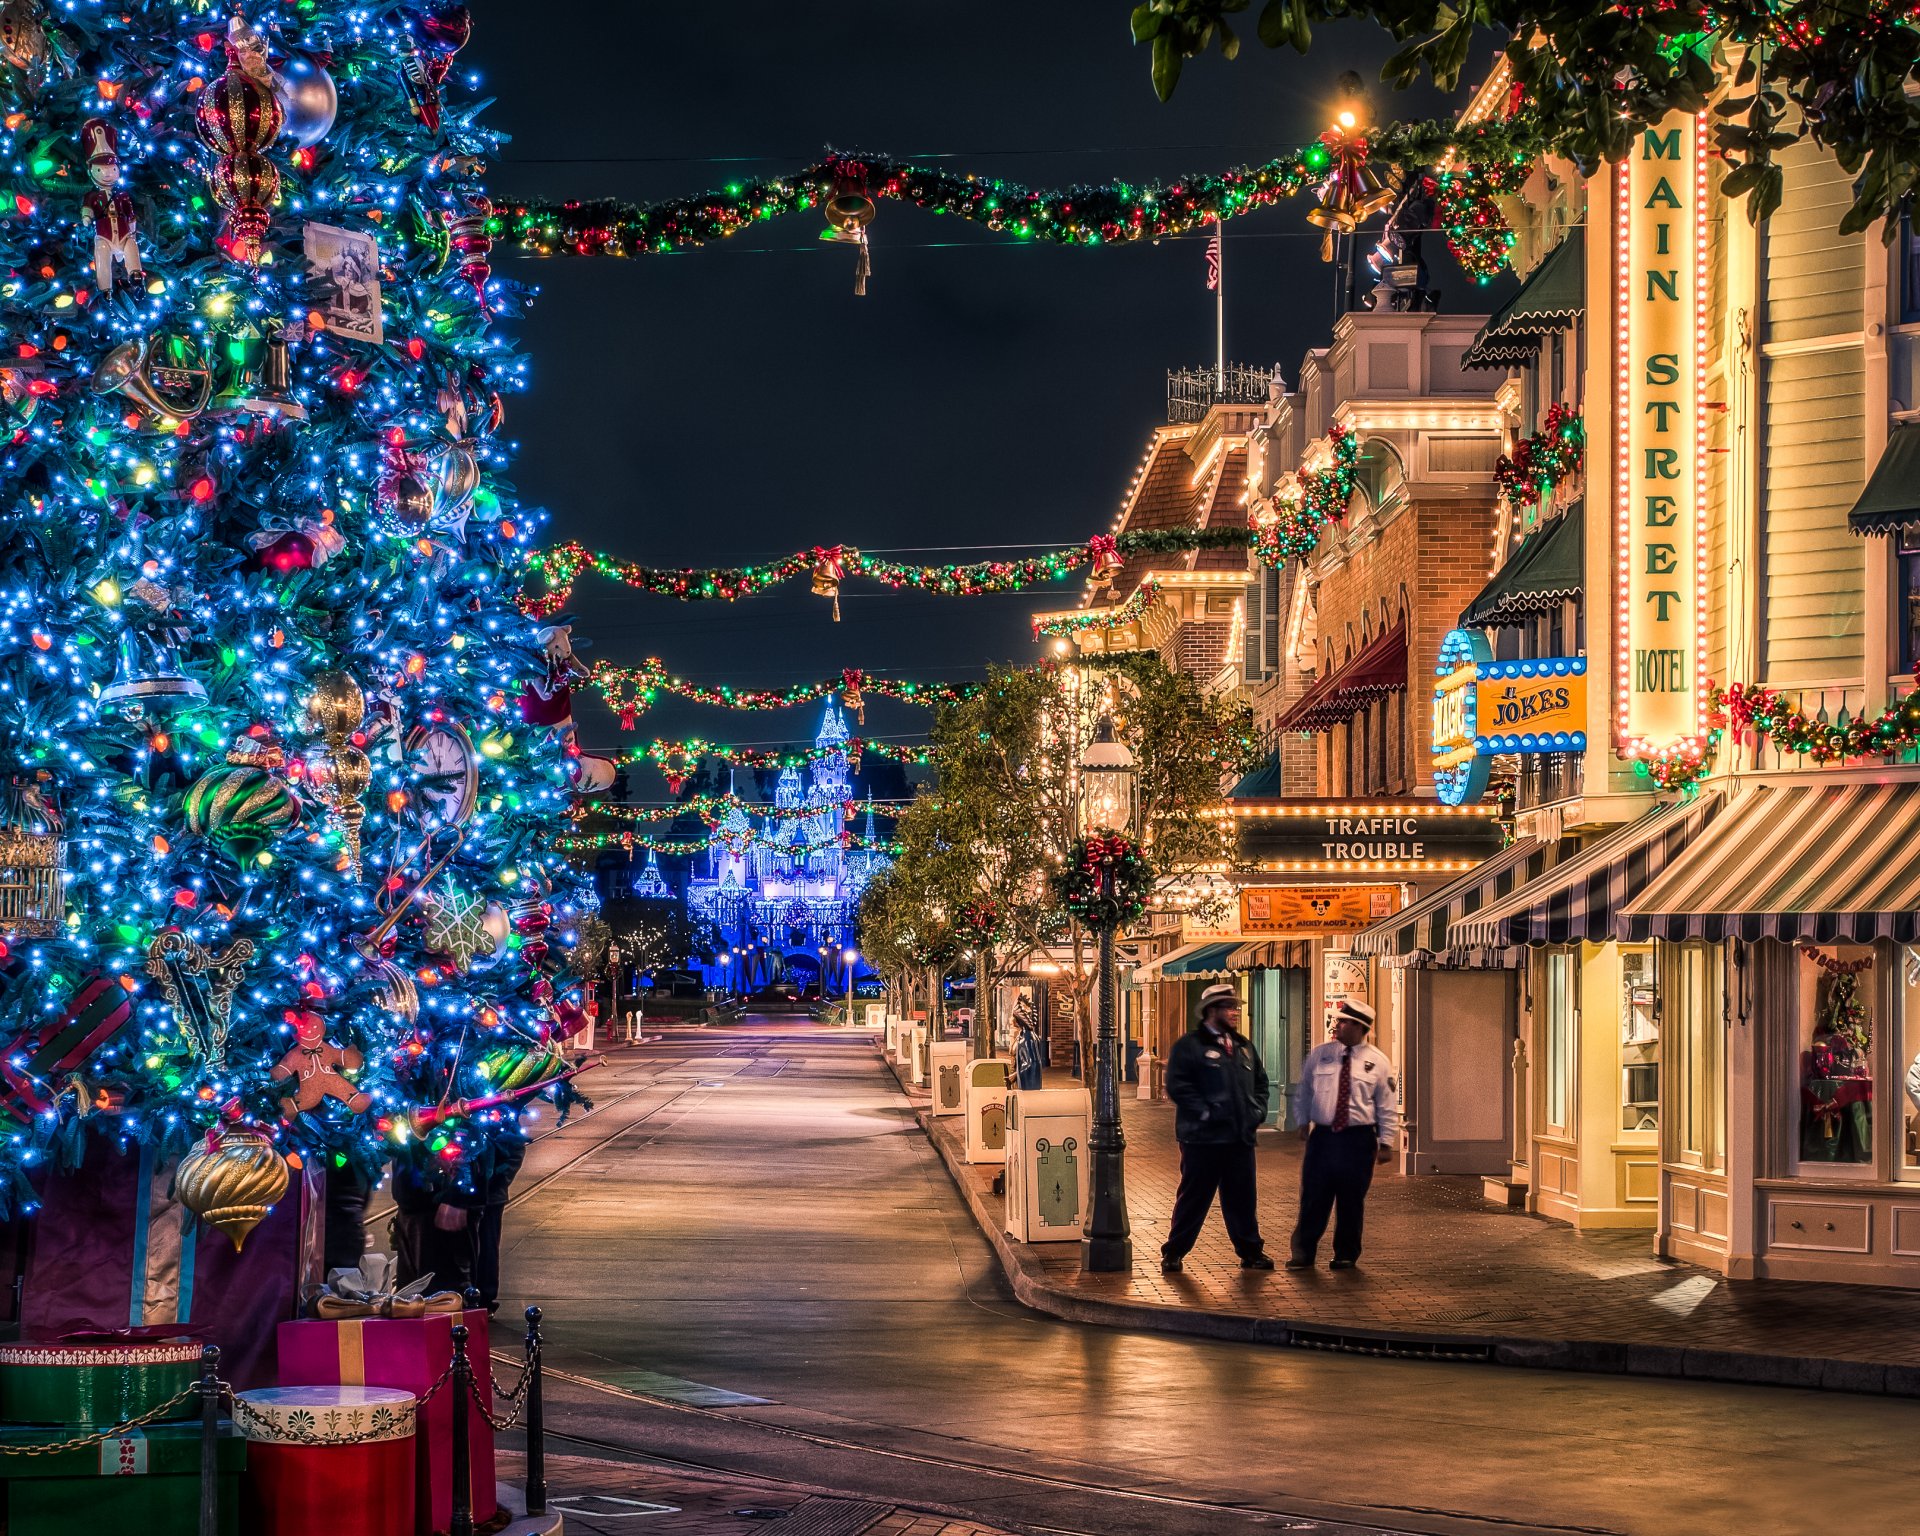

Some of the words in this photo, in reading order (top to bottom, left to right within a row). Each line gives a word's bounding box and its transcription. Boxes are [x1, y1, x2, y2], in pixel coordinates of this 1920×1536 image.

[1642, 129, 1682, 301] MAIN
[1644, 353, 1681, 621] STREET
[1635, 649, 1689, 693] HOTEL
[1492, 686, 1570, 727] JOKES
[1325, 818, 1417, 835] TRAFFIC
[1321, 842, 1425, 859] TROUBLE
[1323, 919, 1348, 927] MOUSE
[1326, 982, 1367, 993] NEMA
